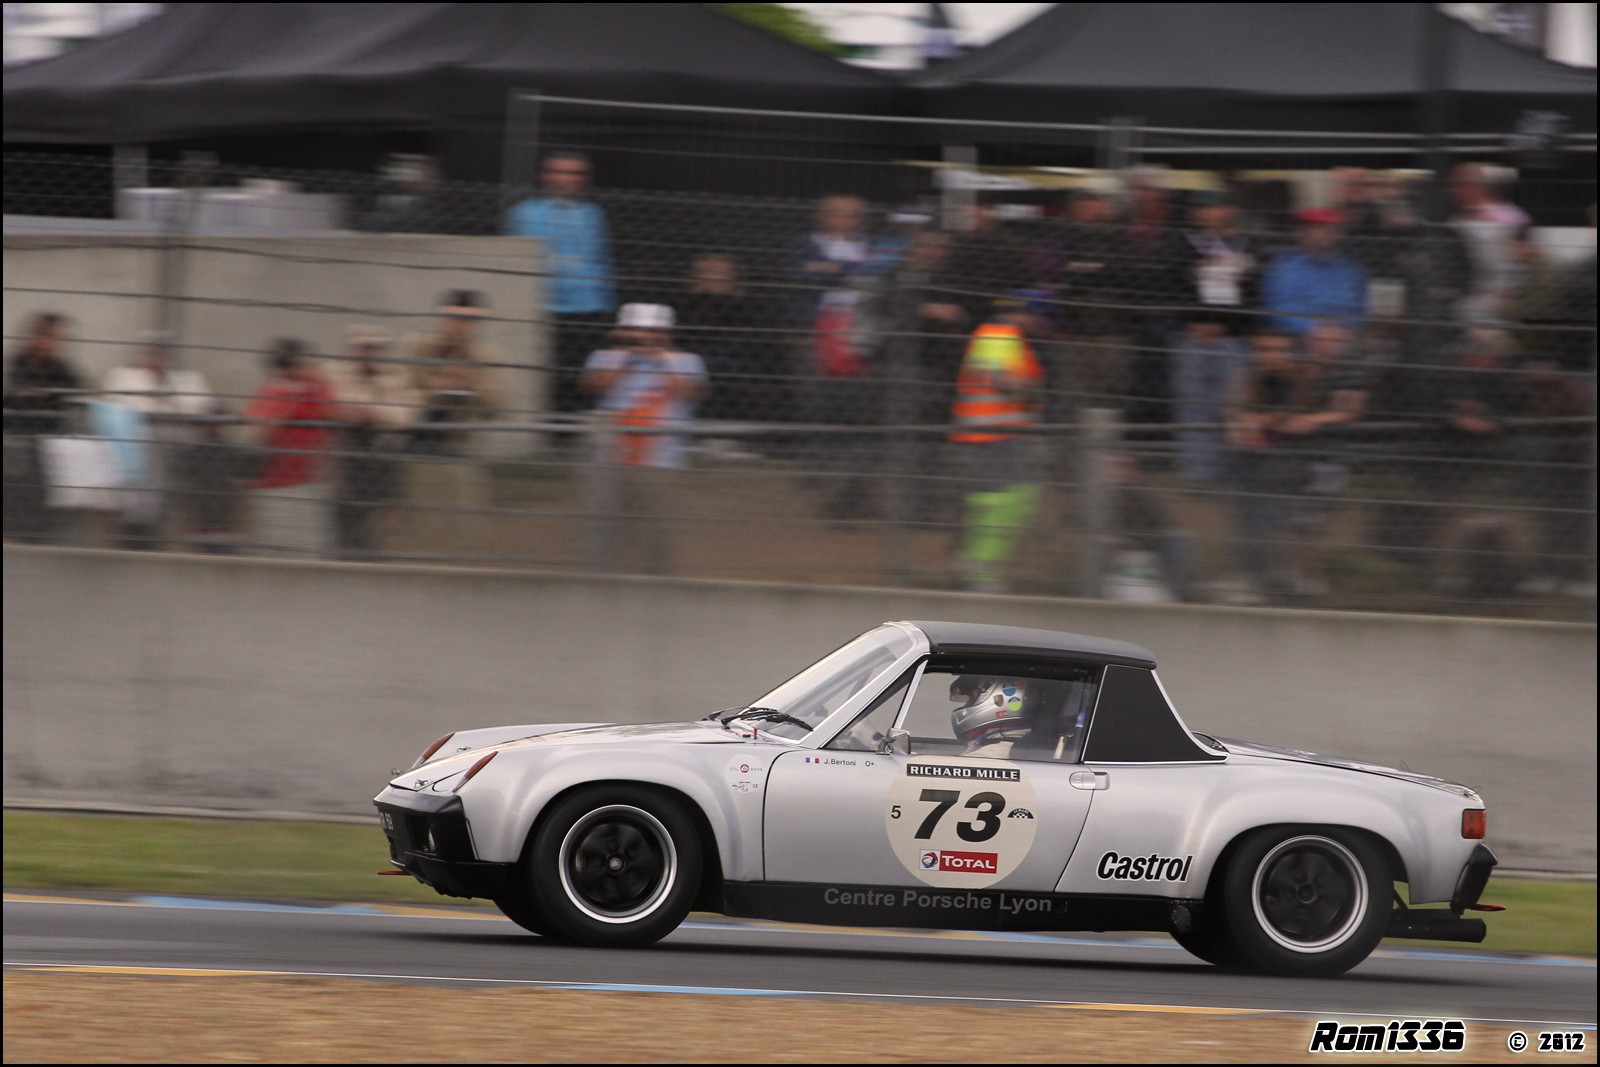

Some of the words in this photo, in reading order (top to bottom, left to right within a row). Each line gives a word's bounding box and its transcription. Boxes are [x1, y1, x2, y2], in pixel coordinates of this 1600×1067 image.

[910, 766, 971, 777] RICHARD
[976, 769, 1018, 780] MILLE
[891, 805, 901, 819] 5
[914, 788, 1006, 843] 73
[1097, 851, 1193, 881] Castrol
[824, 888, 896, 906] Centre
[903, 890, 992, 910] Porsche
[1000, 893, 1051, 914] Lyon
